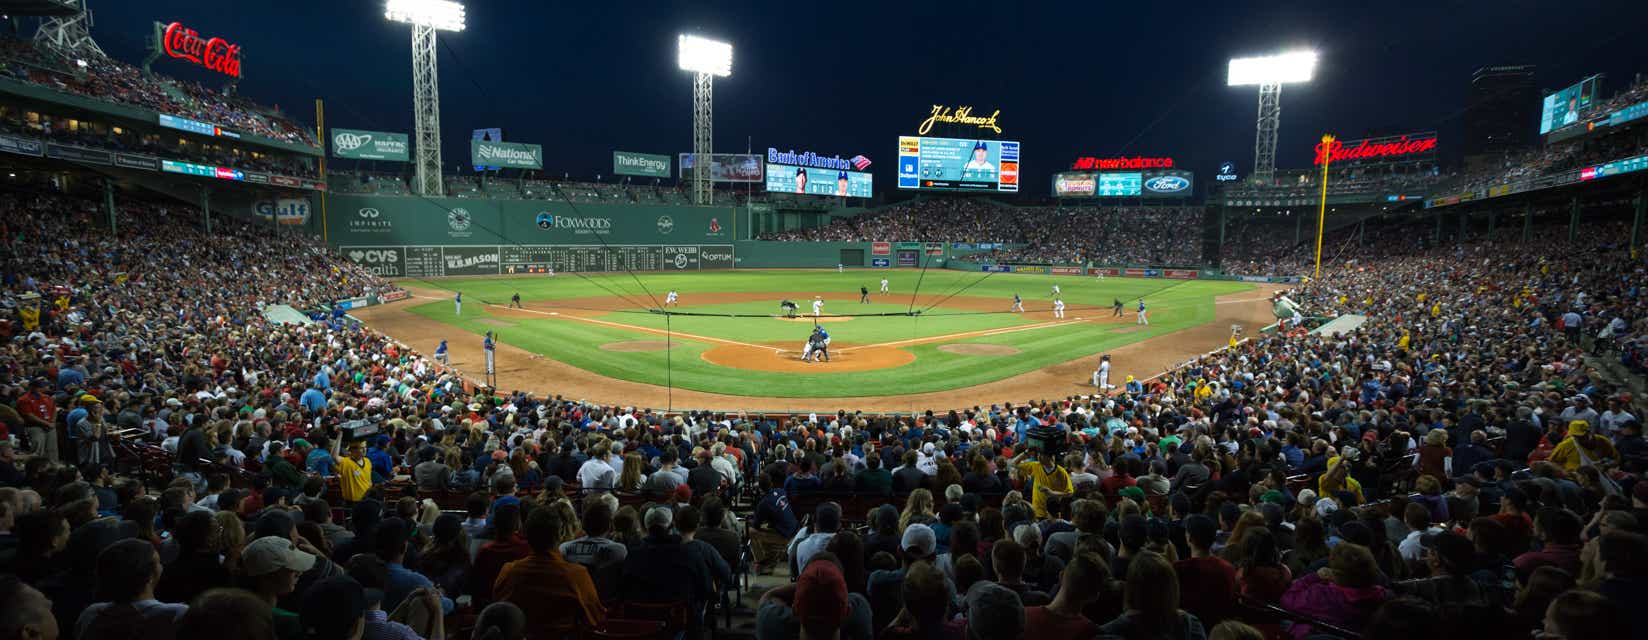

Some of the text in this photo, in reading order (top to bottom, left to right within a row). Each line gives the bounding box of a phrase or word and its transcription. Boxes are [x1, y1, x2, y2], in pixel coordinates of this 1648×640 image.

[919, 105, 1002, 135] John Hancock
[492, 146, 536, 160] National
[1314, 136, 1437, 165] Budweiser
[768, 148, 850, 170] Bank of America
[1152, 178, 1182, 190] Ford
[1216, 174, 1238, 182] tyco
[255, 202, 306, 216] Gulf
[365, 250, 398, 263] CVS
[709, 253, 732, 261] OPTUM
